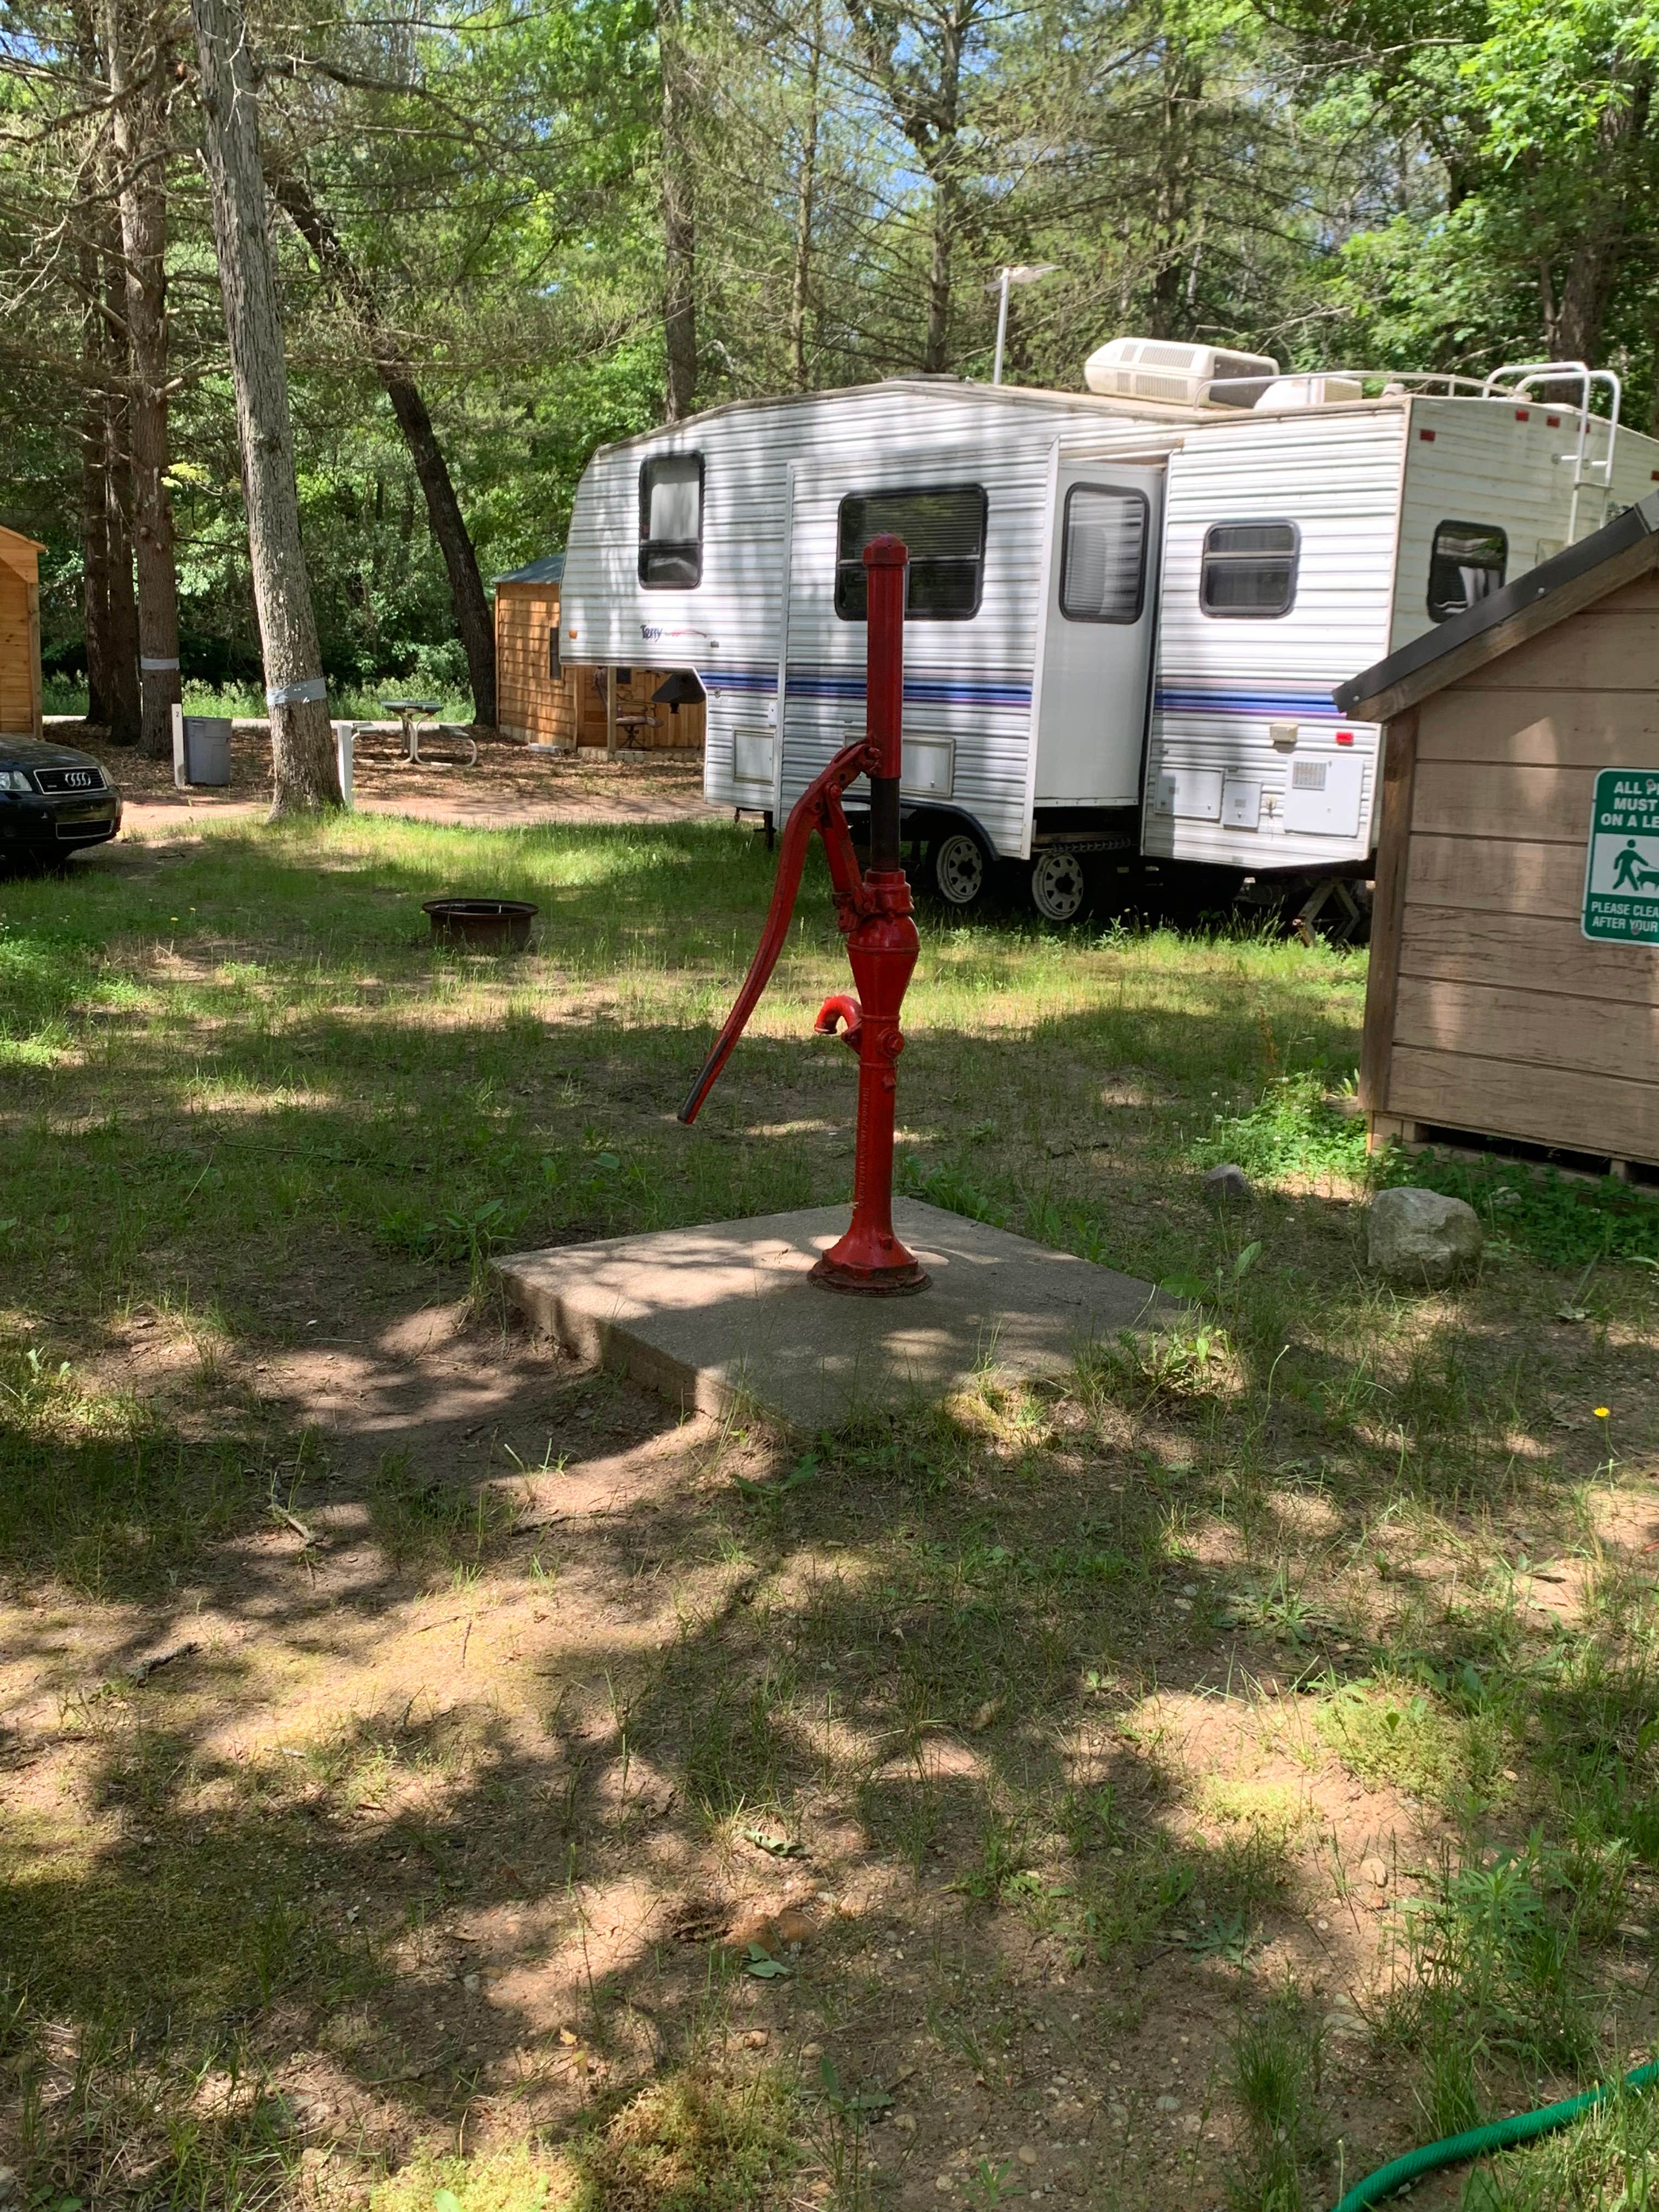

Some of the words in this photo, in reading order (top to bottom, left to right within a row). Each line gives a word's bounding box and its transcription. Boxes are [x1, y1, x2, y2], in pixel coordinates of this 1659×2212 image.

[1614, 781, 1642, 794] ALL
[1614, 798, 1657, 811] MUST
[1601, 813, 1623, 826] ON
[1627, 814, 1638, 827] A
[1592, 901, 1630, 915] PLEASE
[1633, 905, 1659, 918] CLEA
[1592, 916, 1626, 929] AFTER
[1629, 919, 1658, 933] YOUR
